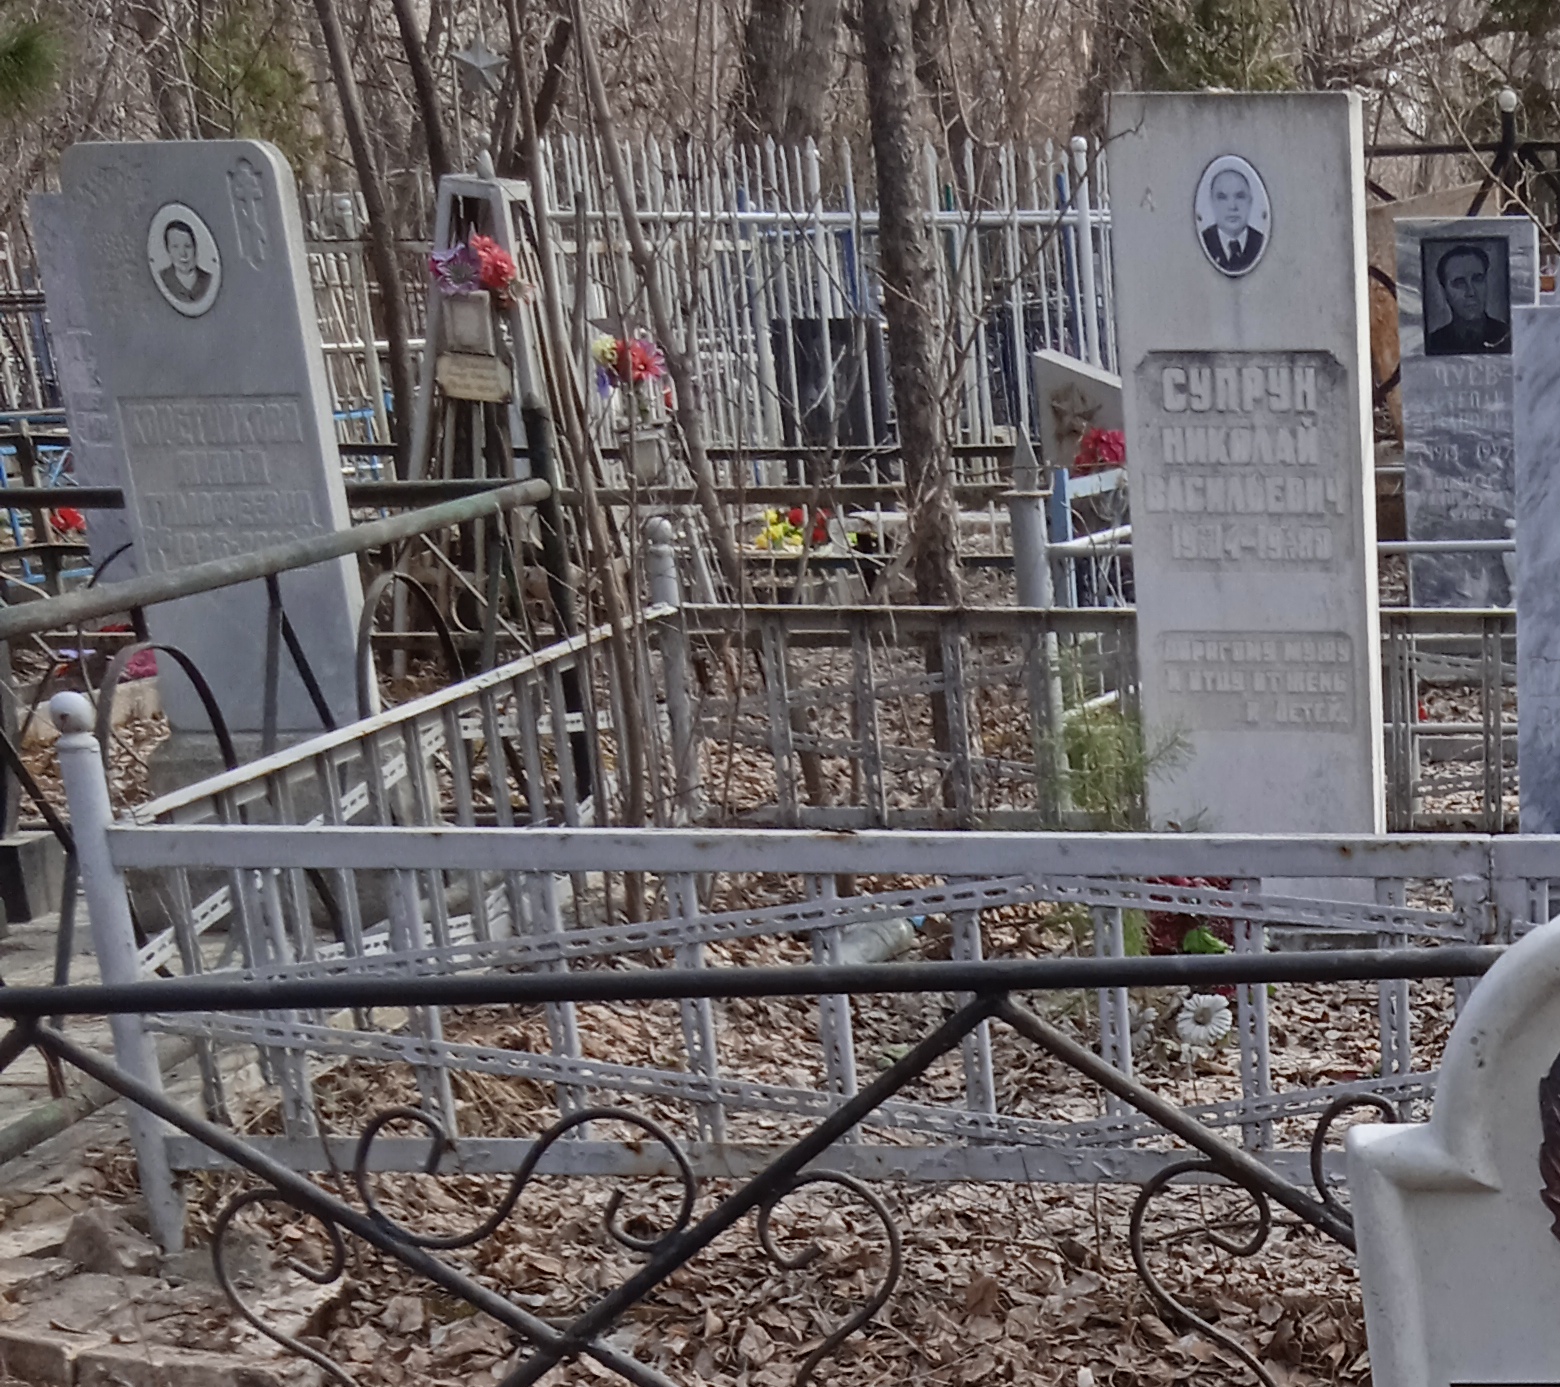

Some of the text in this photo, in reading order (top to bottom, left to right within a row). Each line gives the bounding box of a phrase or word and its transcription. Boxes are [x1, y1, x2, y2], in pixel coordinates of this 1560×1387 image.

[1161, 366, 1317, 414] СУПРУН
[1161, 415, 1319, 466] НИКОЛАЙ
[1144, 473, 1344, 515] ВАСИЛЬЕВИЧ
[1284, 640, 1350, 663] МУЖУ
[1253, 670, 1281, 693] ОТ
